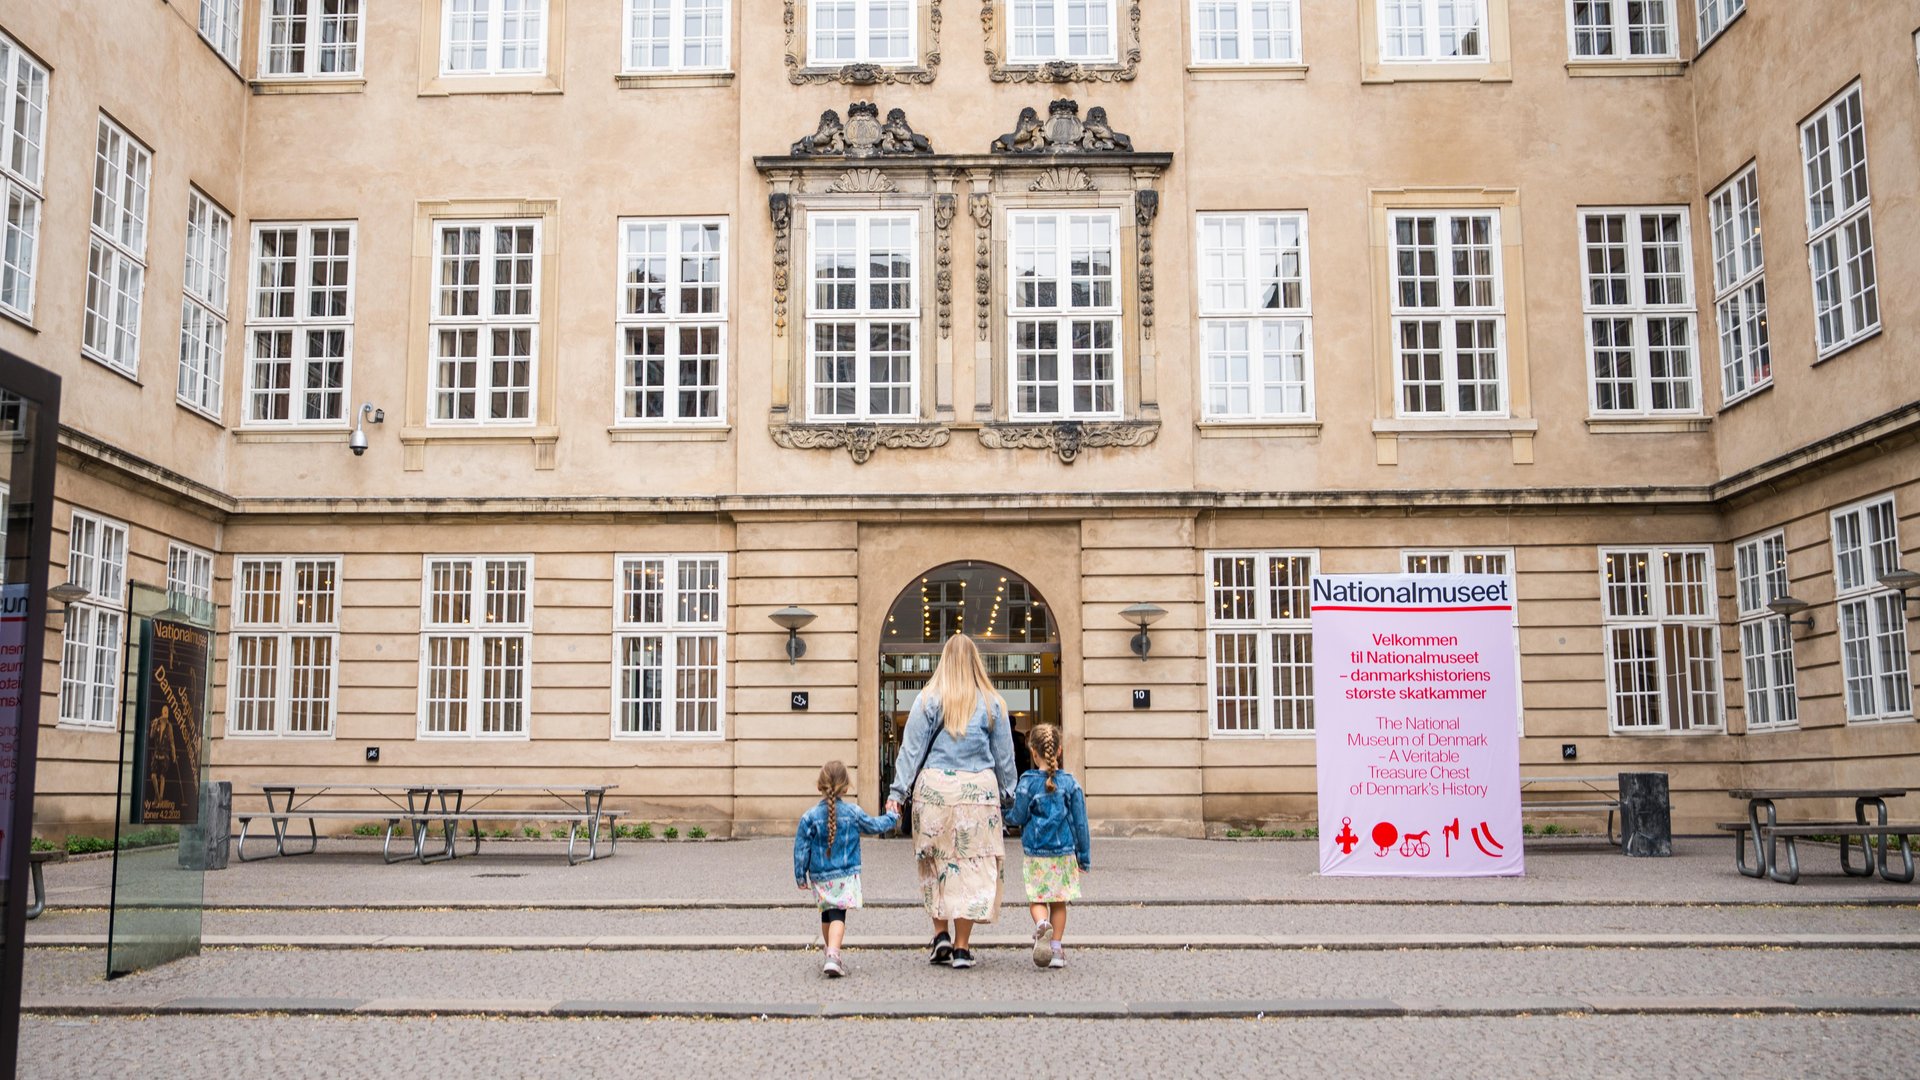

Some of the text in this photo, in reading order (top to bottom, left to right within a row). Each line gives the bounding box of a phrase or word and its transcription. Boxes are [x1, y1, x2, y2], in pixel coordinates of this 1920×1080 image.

[1313, 578, 1508, 603] Nationalmuseet
[1372, 633, 1458, 647] Velkommen
[1350, 650, 1480, 665] til Nationalmuseet
[1350, 668, 1491, 682] danmarkshistoriens
[1134, 690, 1145, 699] 10
[1345, 686, 1487, 701] største skatkammer
[1376, 717, 1460, 730] The National
[1347, 733, 1488, 747] Museum of Denmark
[1389, 750, 1400, 763] A
[1401, 750, 1460, 763] Veritable
[1368, 765, 1470, 779] Treasure Chest
[1350, 782, 1364, 796] of
[1442, 782, 1488, 798] History
